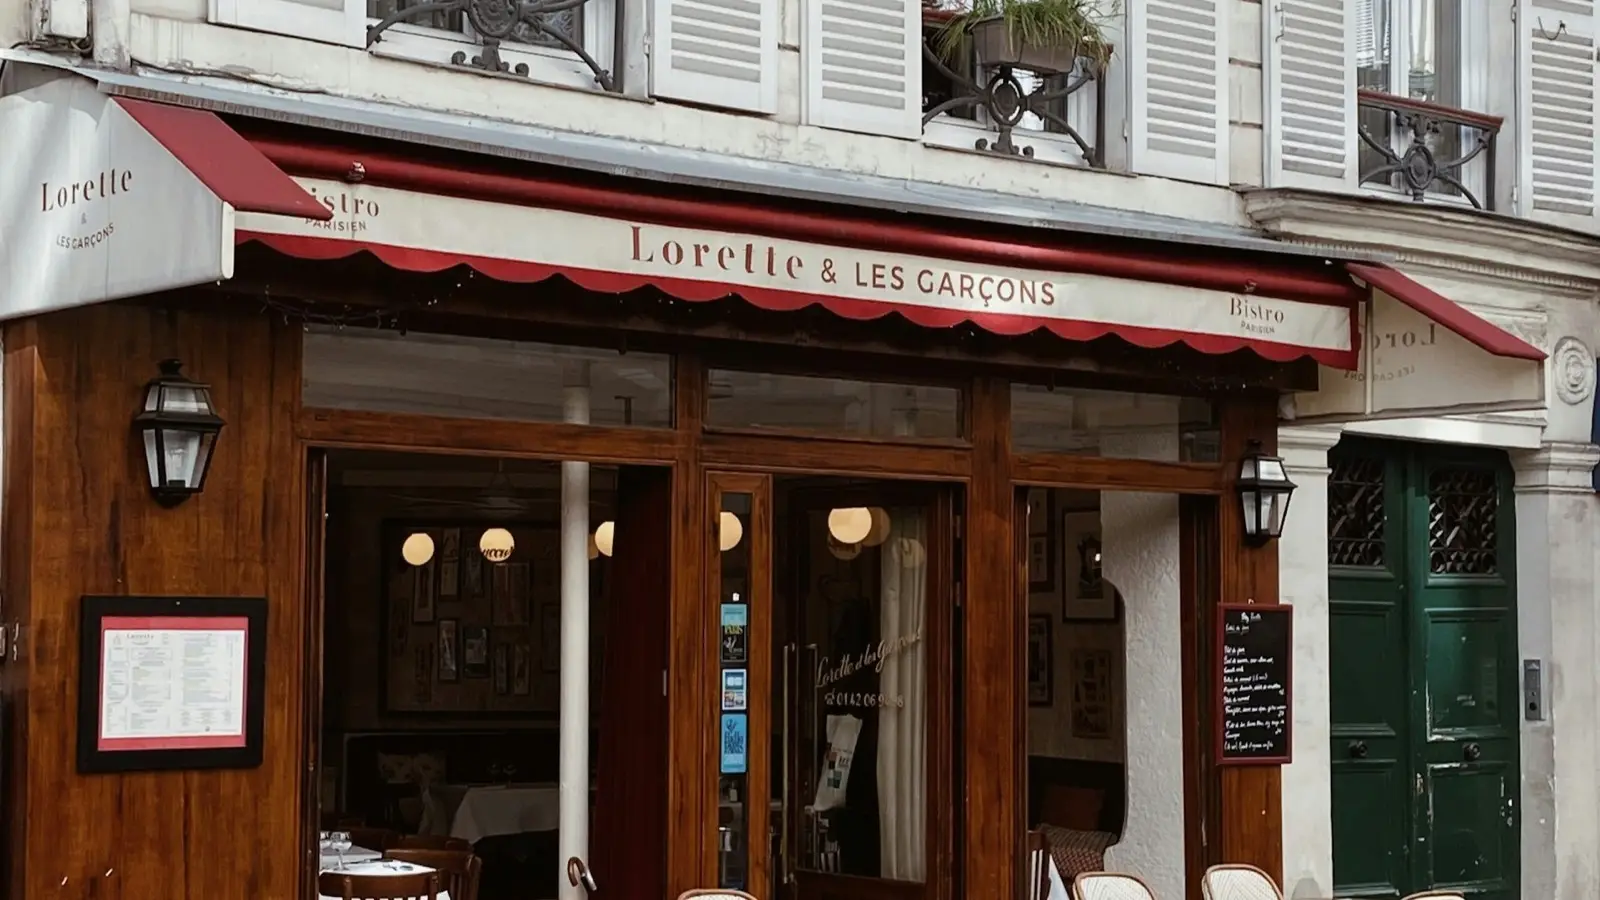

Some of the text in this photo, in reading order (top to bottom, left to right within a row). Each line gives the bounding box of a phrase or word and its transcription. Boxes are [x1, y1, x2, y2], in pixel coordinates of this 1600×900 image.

[42, 168, 132, 212] Lorette
[72, 222, 115, 250] GARÇONS
[305, 218, 367, 231] PARISIEN
[630, 225, 1056, 308] Lorette & LES GARÇONS
[1230, 297, 1284, 323] Bistro
